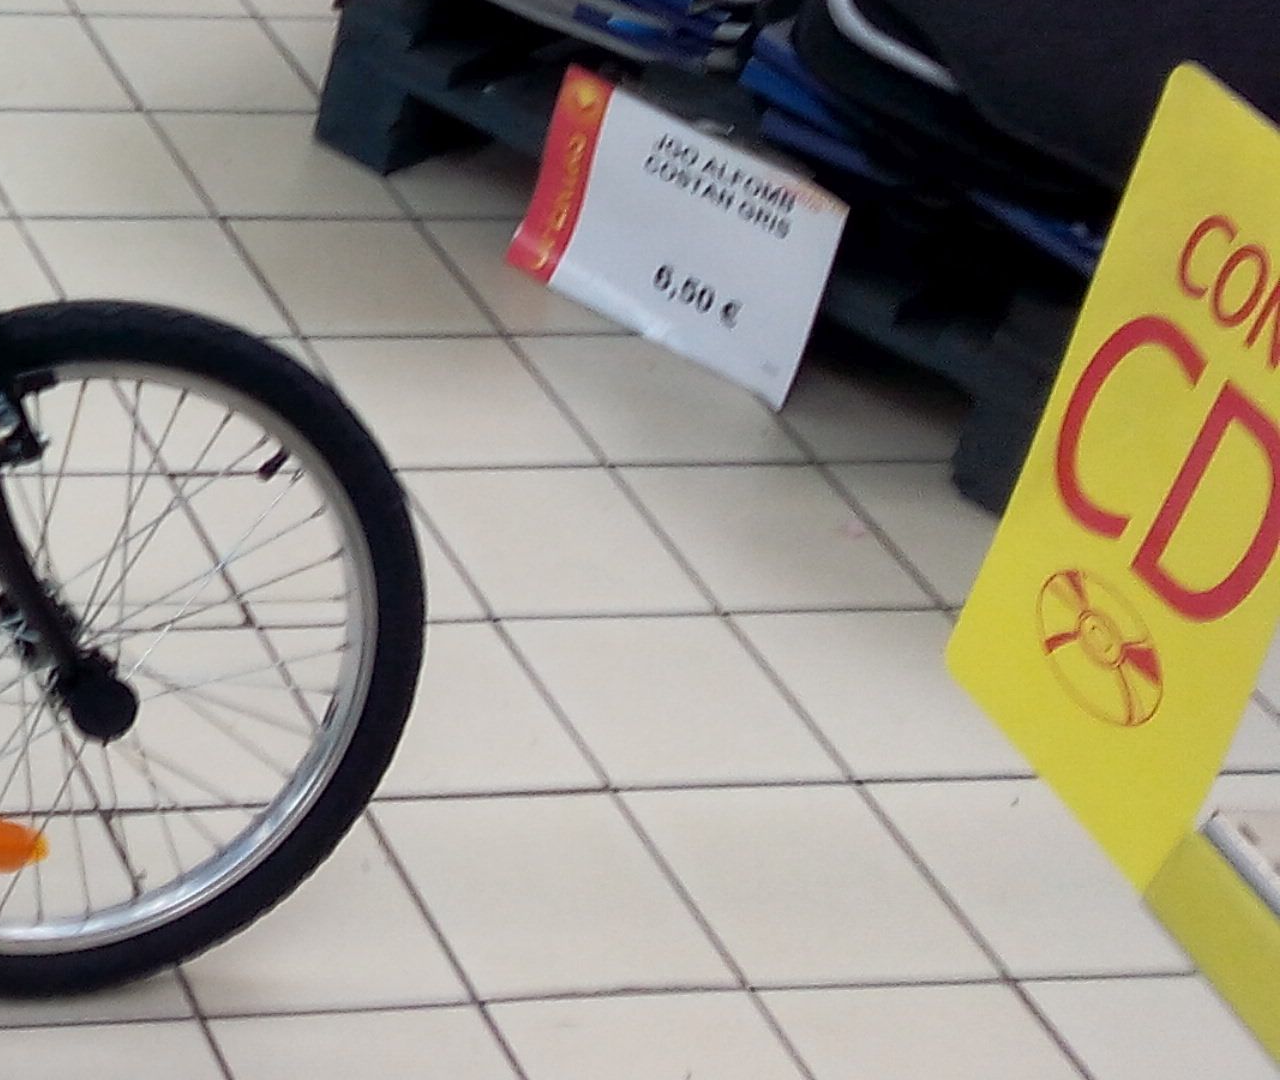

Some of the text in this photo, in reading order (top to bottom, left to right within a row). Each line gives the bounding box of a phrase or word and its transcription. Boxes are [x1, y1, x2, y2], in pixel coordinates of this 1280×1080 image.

[737, 200, 791, 240] GRIS
[653, 264, 716, 314] 6,50
[1054, 315, 1280, 623] CD
